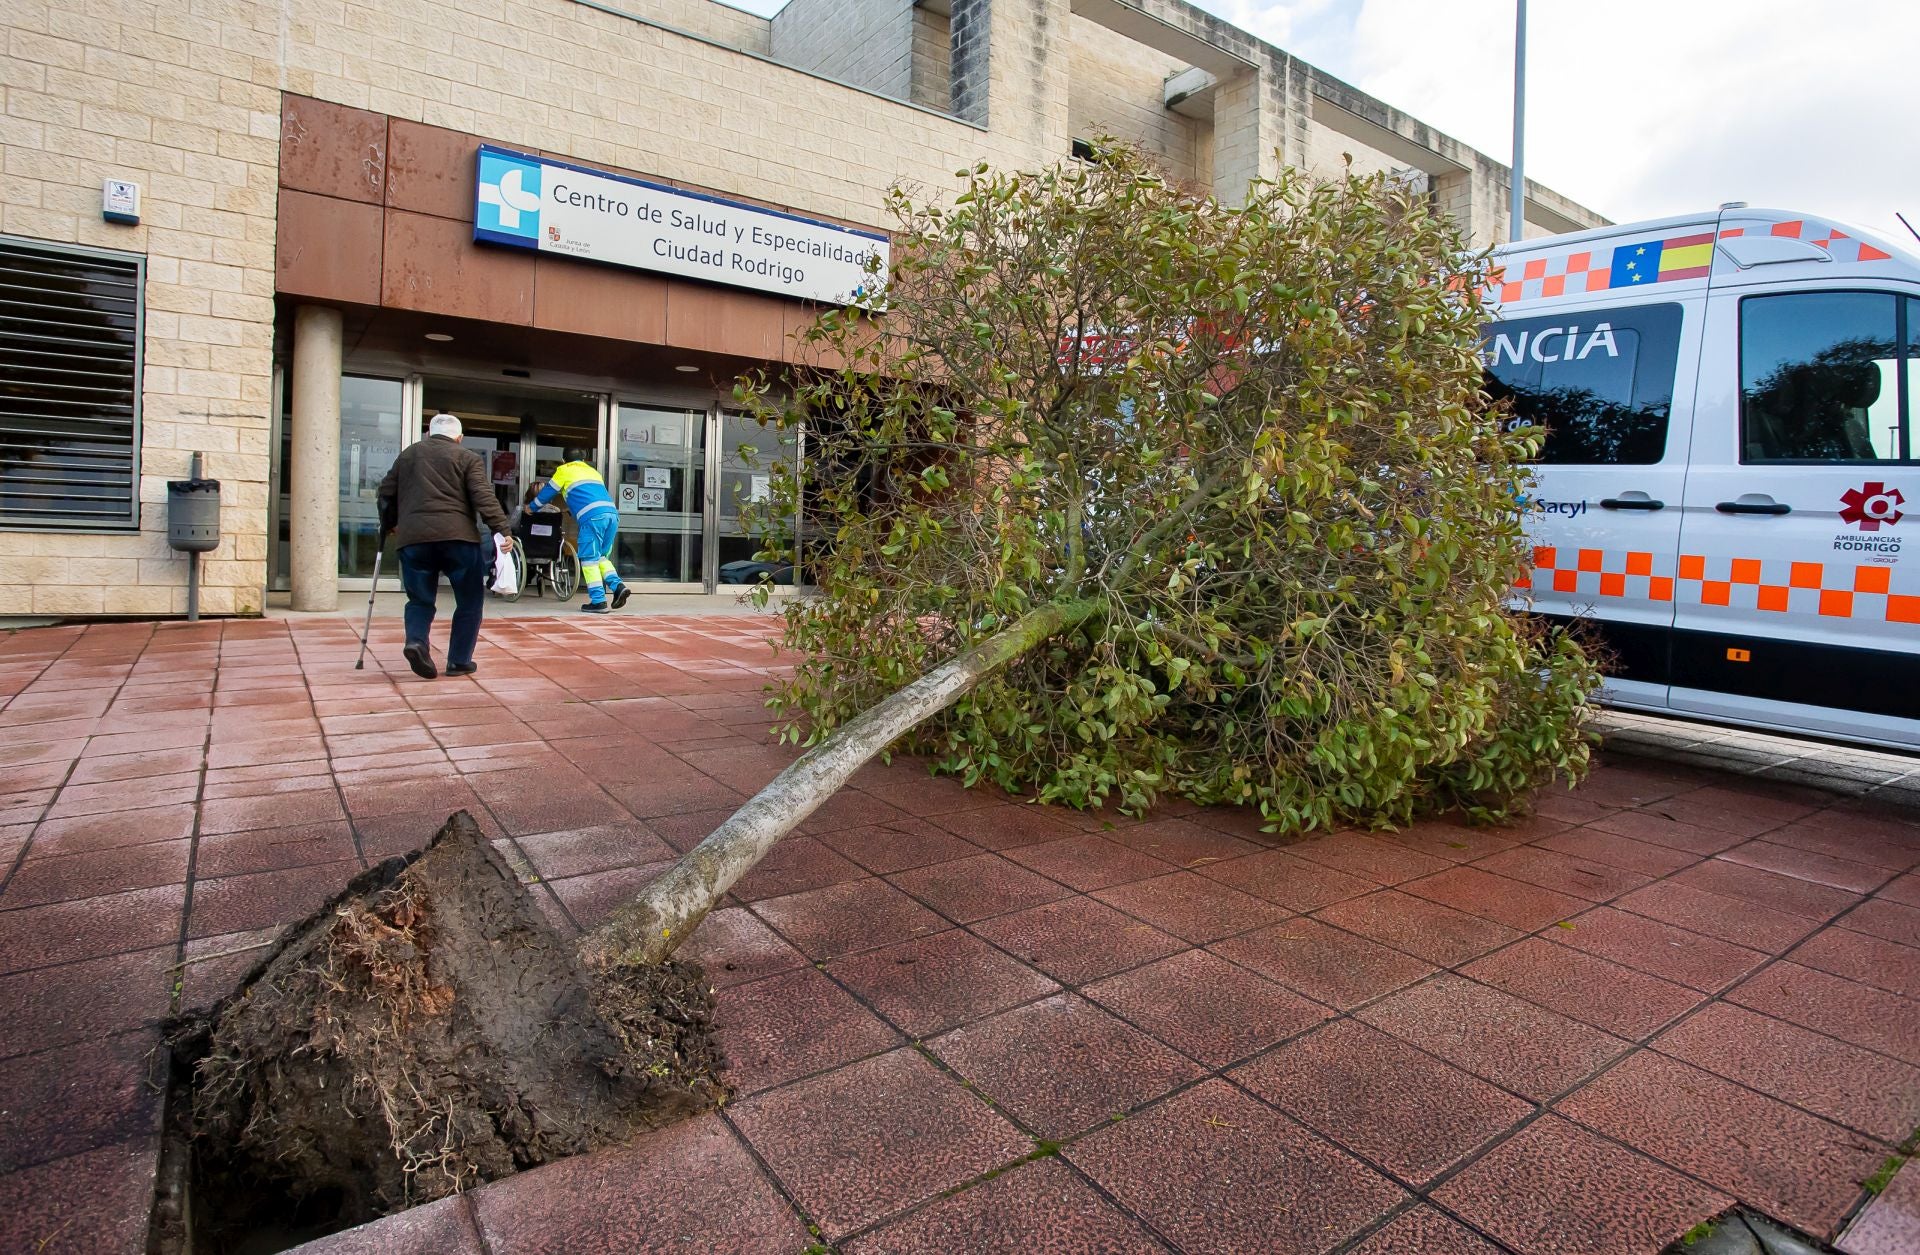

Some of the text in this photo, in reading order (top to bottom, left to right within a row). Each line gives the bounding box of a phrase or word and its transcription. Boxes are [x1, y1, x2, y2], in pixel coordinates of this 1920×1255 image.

[553, 184, 628, 216] Centro
[637, 203, 662, 223] de
[670, 210, 726, 237] Salud
[734, 226, 744, 243] y
[653, 238, 804, 284] Ciudad Rodrigo
[1833, 541, 1901, 553] RODRIGO
[1834, 535, 1902, 543] AMBULANCIAS
